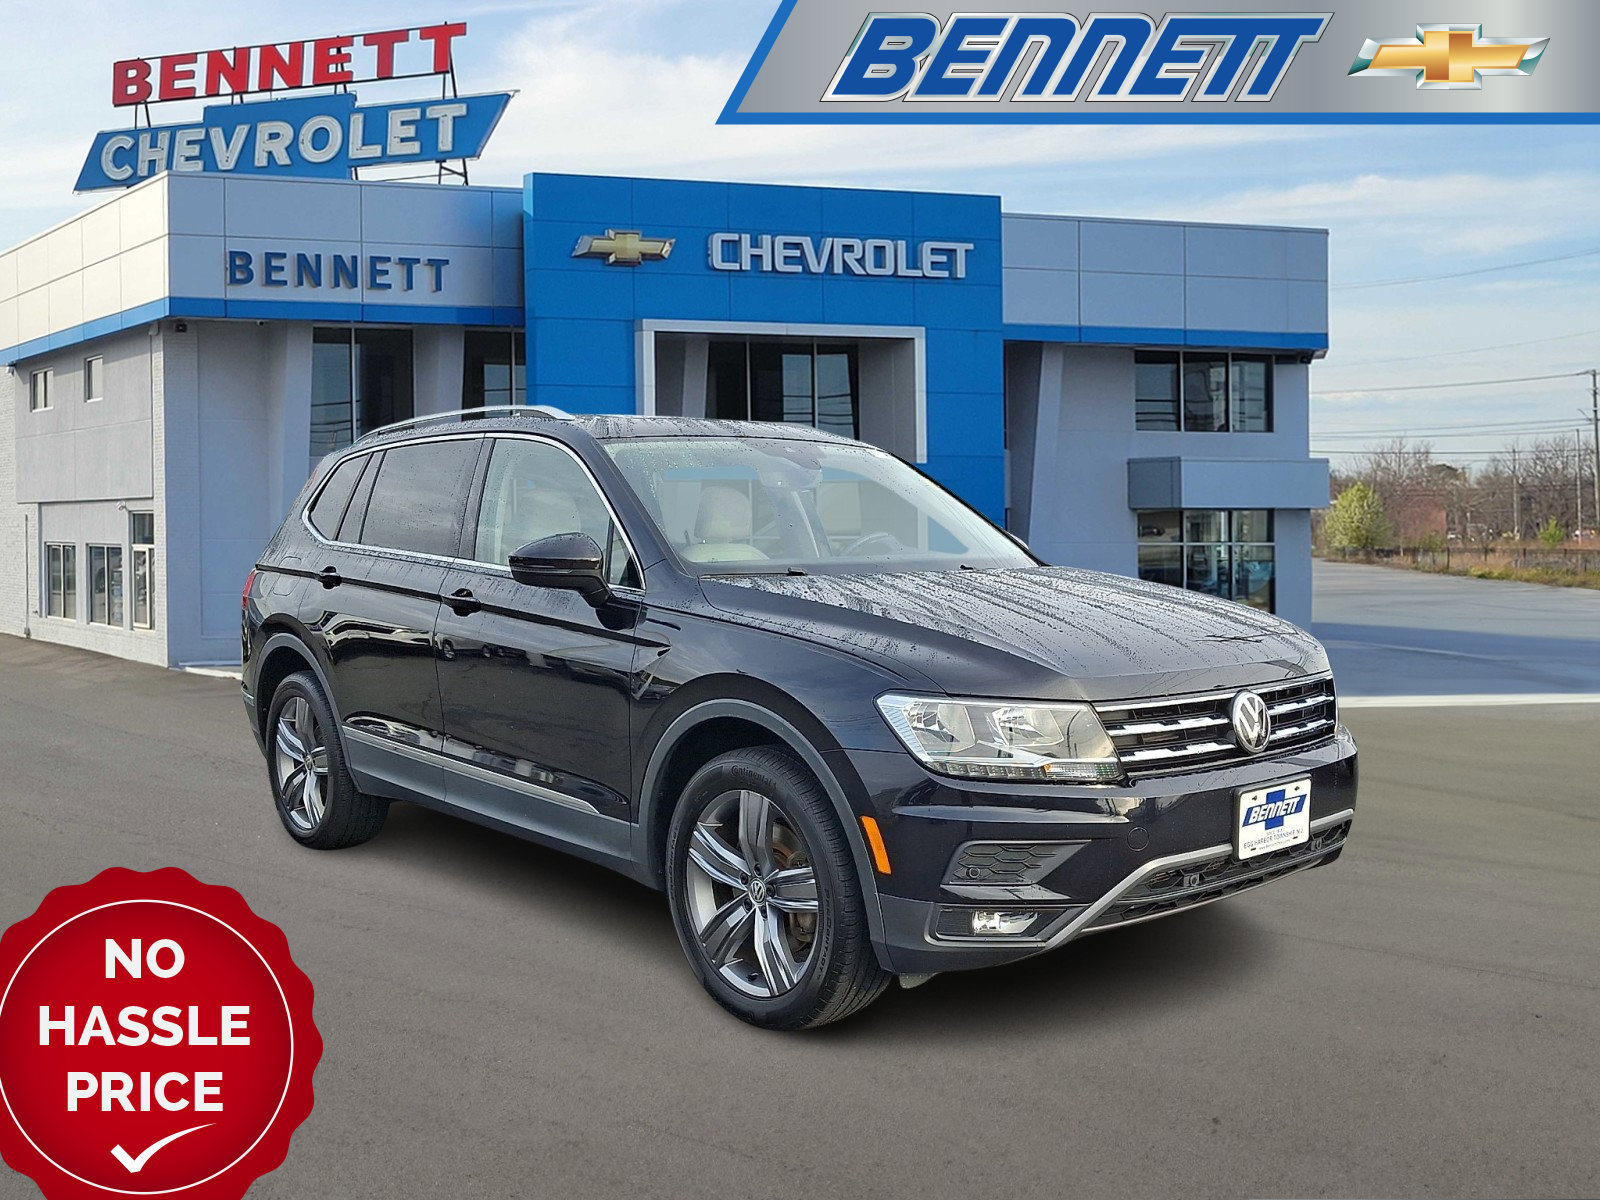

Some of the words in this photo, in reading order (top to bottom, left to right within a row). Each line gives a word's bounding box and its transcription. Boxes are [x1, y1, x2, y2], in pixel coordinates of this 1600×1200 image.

[112, 22, 467, 106] BENNETT
[100, 103, 467, 180] CHEVROLET
[227, 249, 450, 292] BENNETT
[708, 232, 975, 278] CHEVROLET
[1248, 796, 1301, 824] BENNETT
